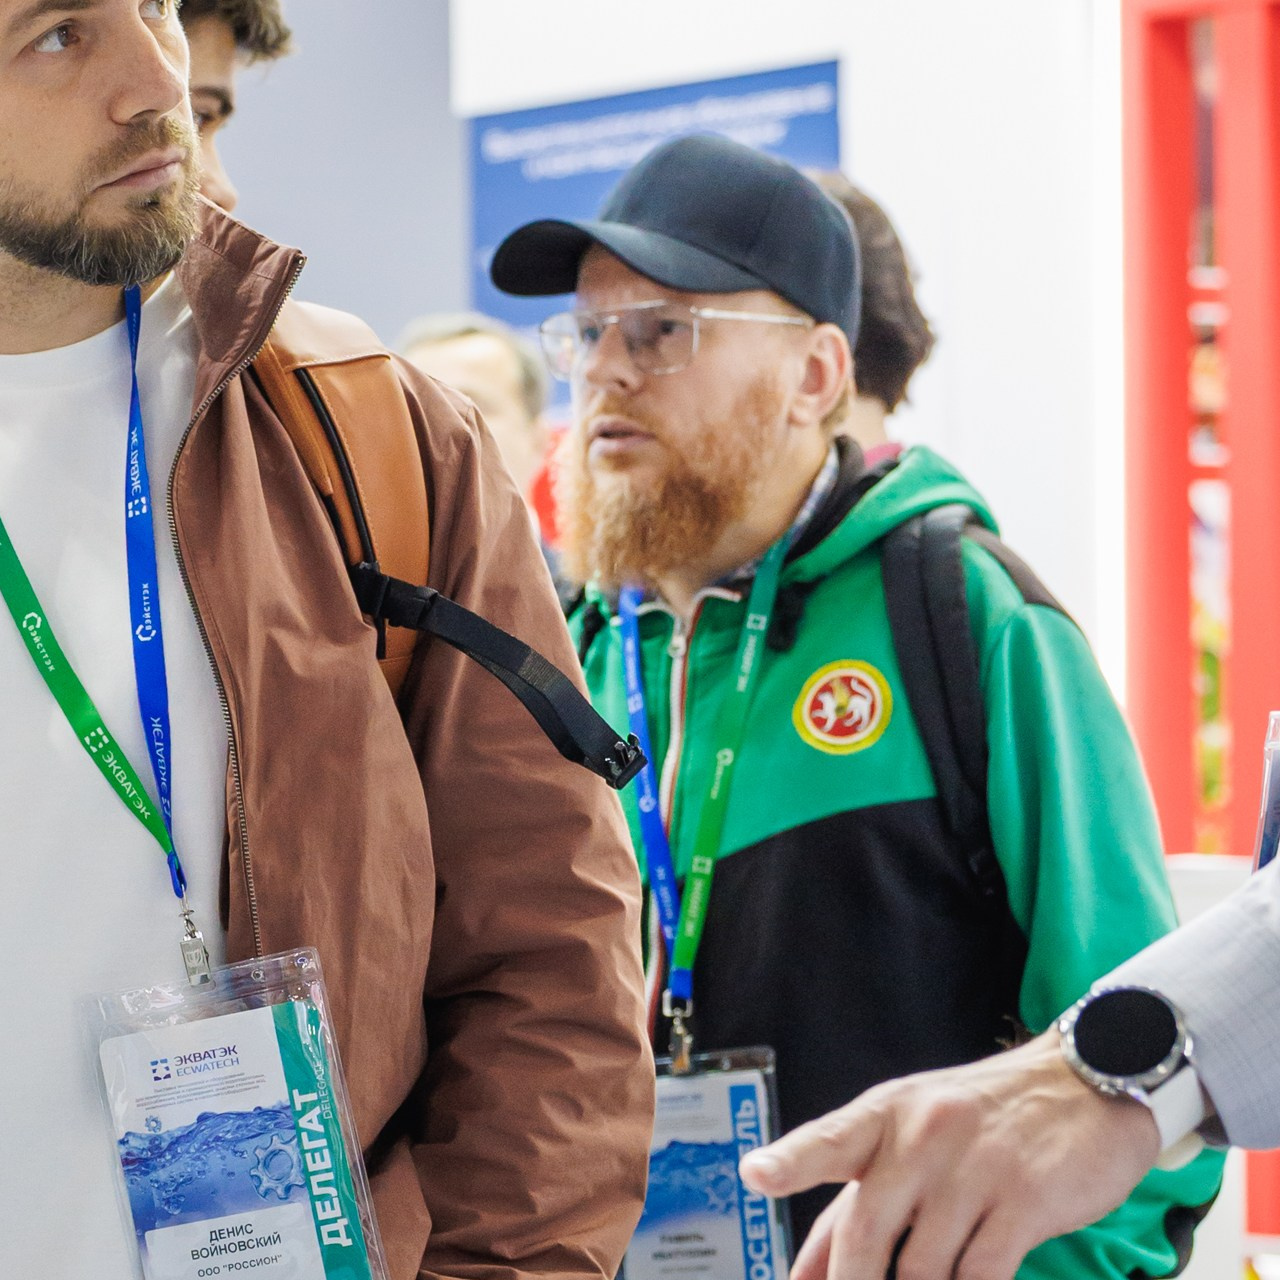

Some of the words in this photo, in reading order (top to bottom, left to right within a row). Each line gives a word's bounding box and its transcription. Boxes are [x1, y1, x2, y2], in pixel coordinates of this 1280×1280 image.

[130, 427, 142, 497] ЭКВАТЭК
[150, 716, 168, 792] ЭКВАТЭК
[102, 751, 151, 820] ЭКВАТЭК
[174, 1045, 238, 1066] ЭКВАТЭК
[176, 1057, 240, 1077] ECWATECH
[293, 1088, 353, 1247] ДЕЛЕГАТ
[191, 1231, 281, 1260] ВОЙНОВСКИЙ
[209, 1223, 253, 1243] ДЕНИС
[198, 1266, 220, 1277] ООО
[223, 1254, 282, 1272] "РОССИОН"
